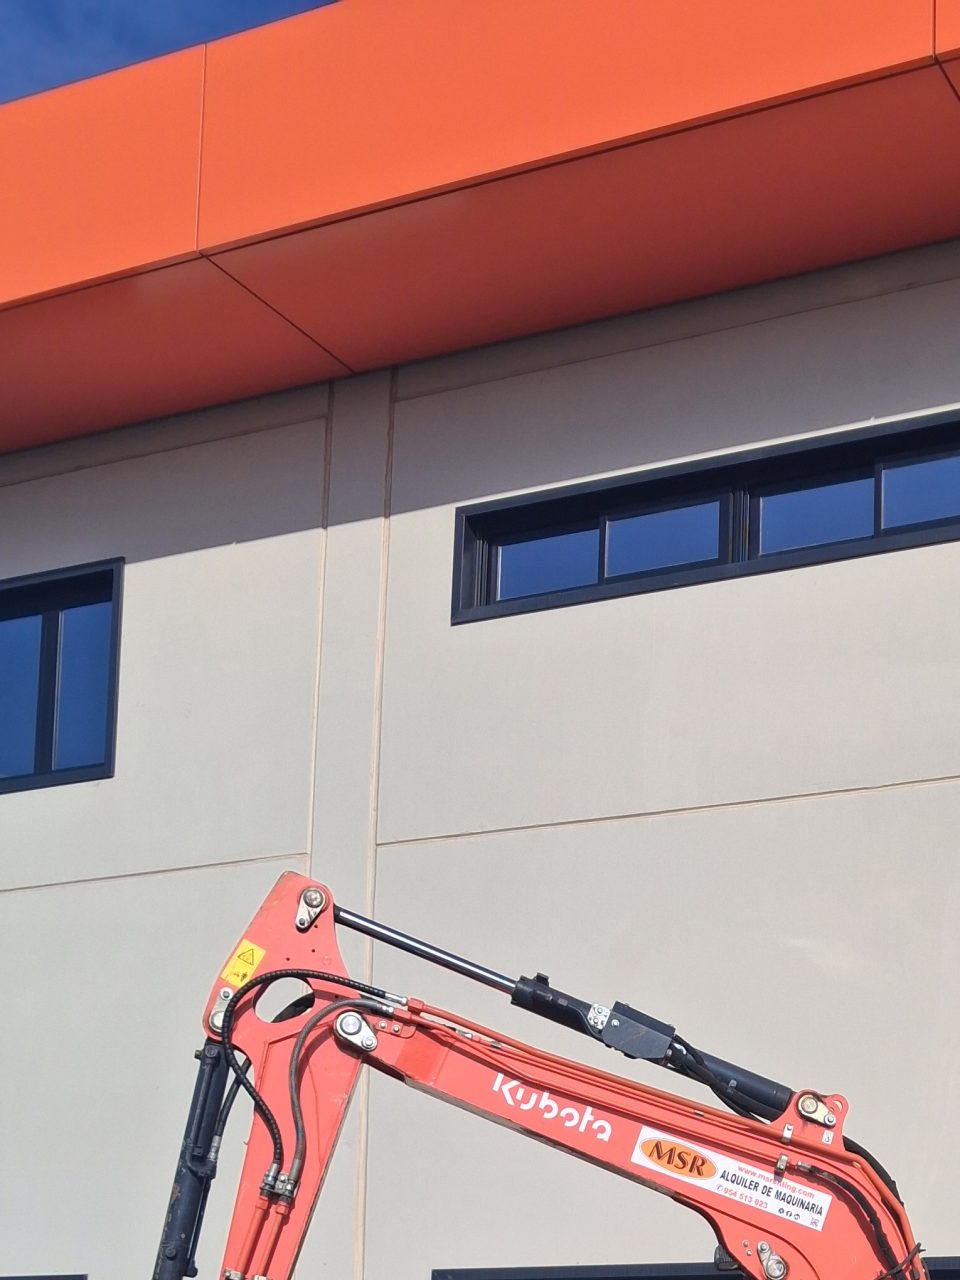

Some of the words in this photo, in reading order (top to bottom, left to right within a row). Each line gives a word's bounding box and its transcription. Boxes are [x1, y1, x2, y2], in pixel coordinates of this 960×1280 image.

[492, 1072, 612, 1142] Kubota
[649, 1140, 707, 1176] MSR
[720, 1170, 760, 1192] ALQUILER
[761, 1185, 773, 1197] DE
[774, 1190, 823, 1216] MAQUINARIA
